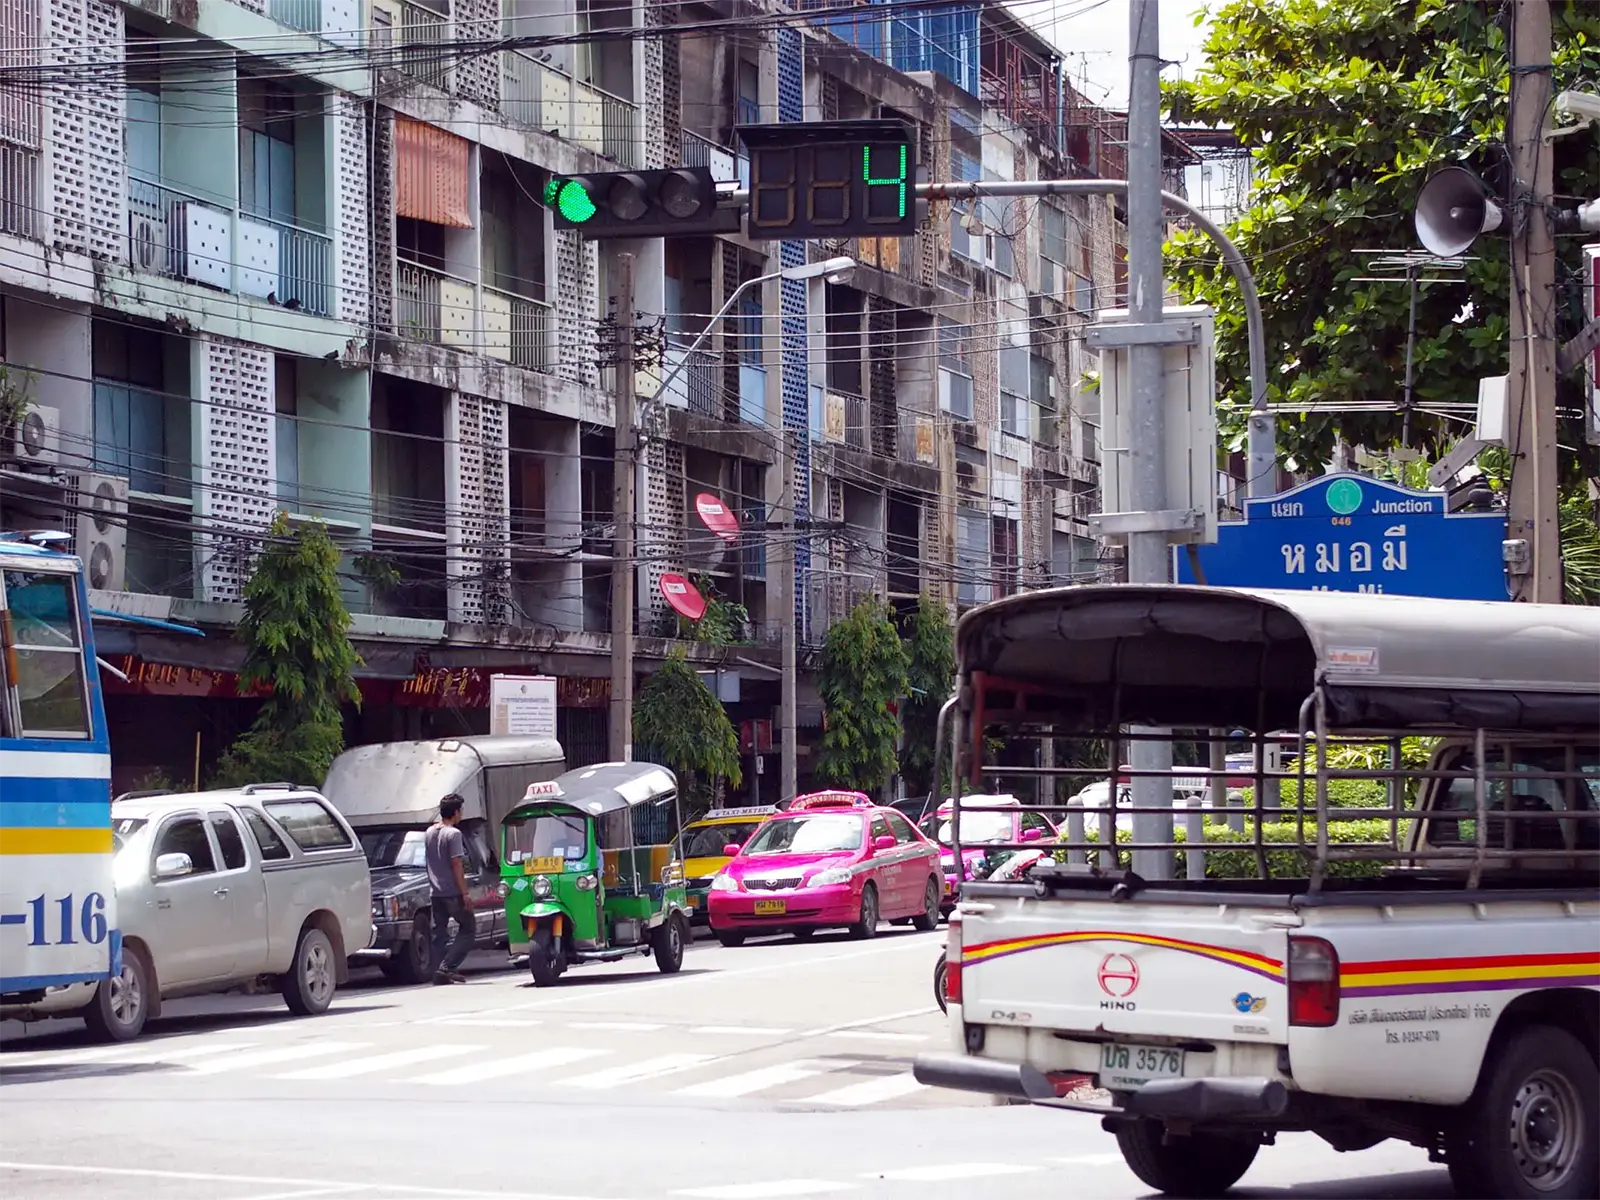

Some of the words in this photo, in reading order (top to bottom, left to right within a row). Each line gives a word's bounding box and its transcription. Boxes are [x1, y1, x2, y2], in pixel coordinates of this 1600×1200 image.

[863, 145, 906, 217] 4
[1271, 502, 1304, 517] แยก
[1371, 499, 1433, 514] Junction
[1331, 517, 1351, 526] 046
[1281, 524, 1408, 574] หมอมี
[531, 784, 553, 795] TAXI
[721, 806, 769, 817] TAXI-METER
[1100, 1000, 1136, 1011] HINO
[1136, 1049, 1180, 1073] 3576
